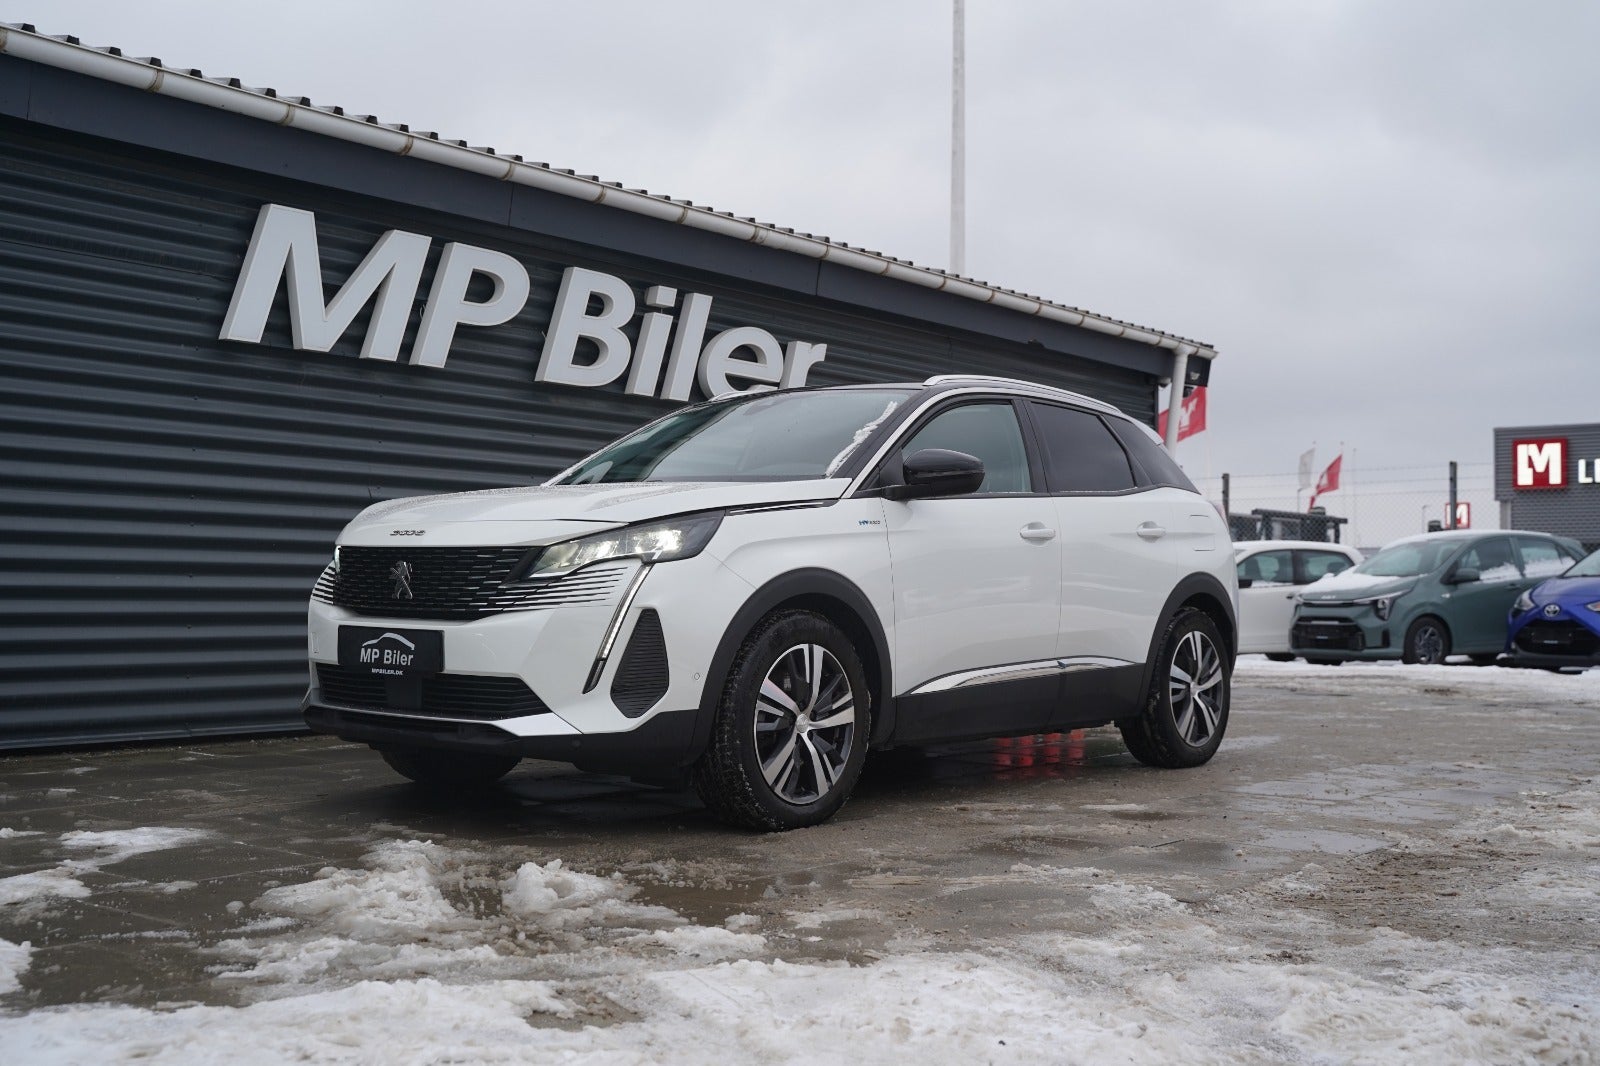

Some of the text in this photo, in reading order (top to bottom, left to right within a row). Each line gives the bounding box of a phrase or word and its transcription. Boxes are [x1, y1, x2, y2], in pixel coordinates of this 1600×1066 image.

[218, 203, 827, 401] MP Biler
[359, 647, 414, 666] MP Biler
